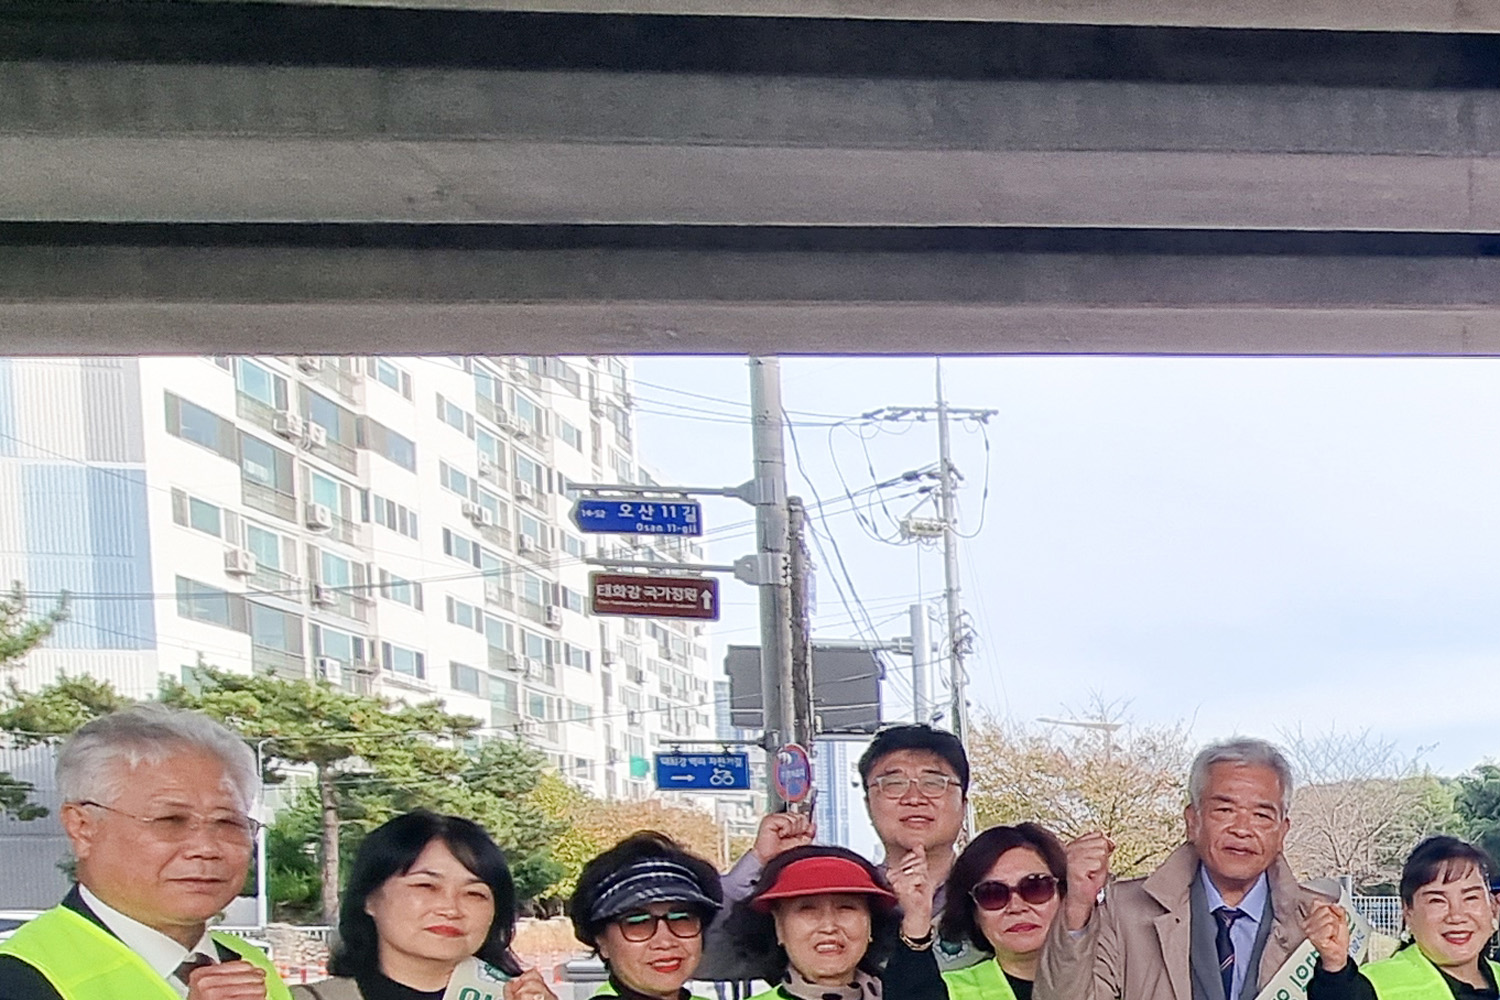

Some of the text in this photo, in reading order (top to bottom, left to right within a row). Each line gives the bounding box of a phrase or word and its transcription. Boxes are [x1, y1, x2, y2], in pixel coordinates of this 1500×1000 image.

[636, 522, 663, 532] Osan
[596, 583, 698, 602] 태화강 국가정원
